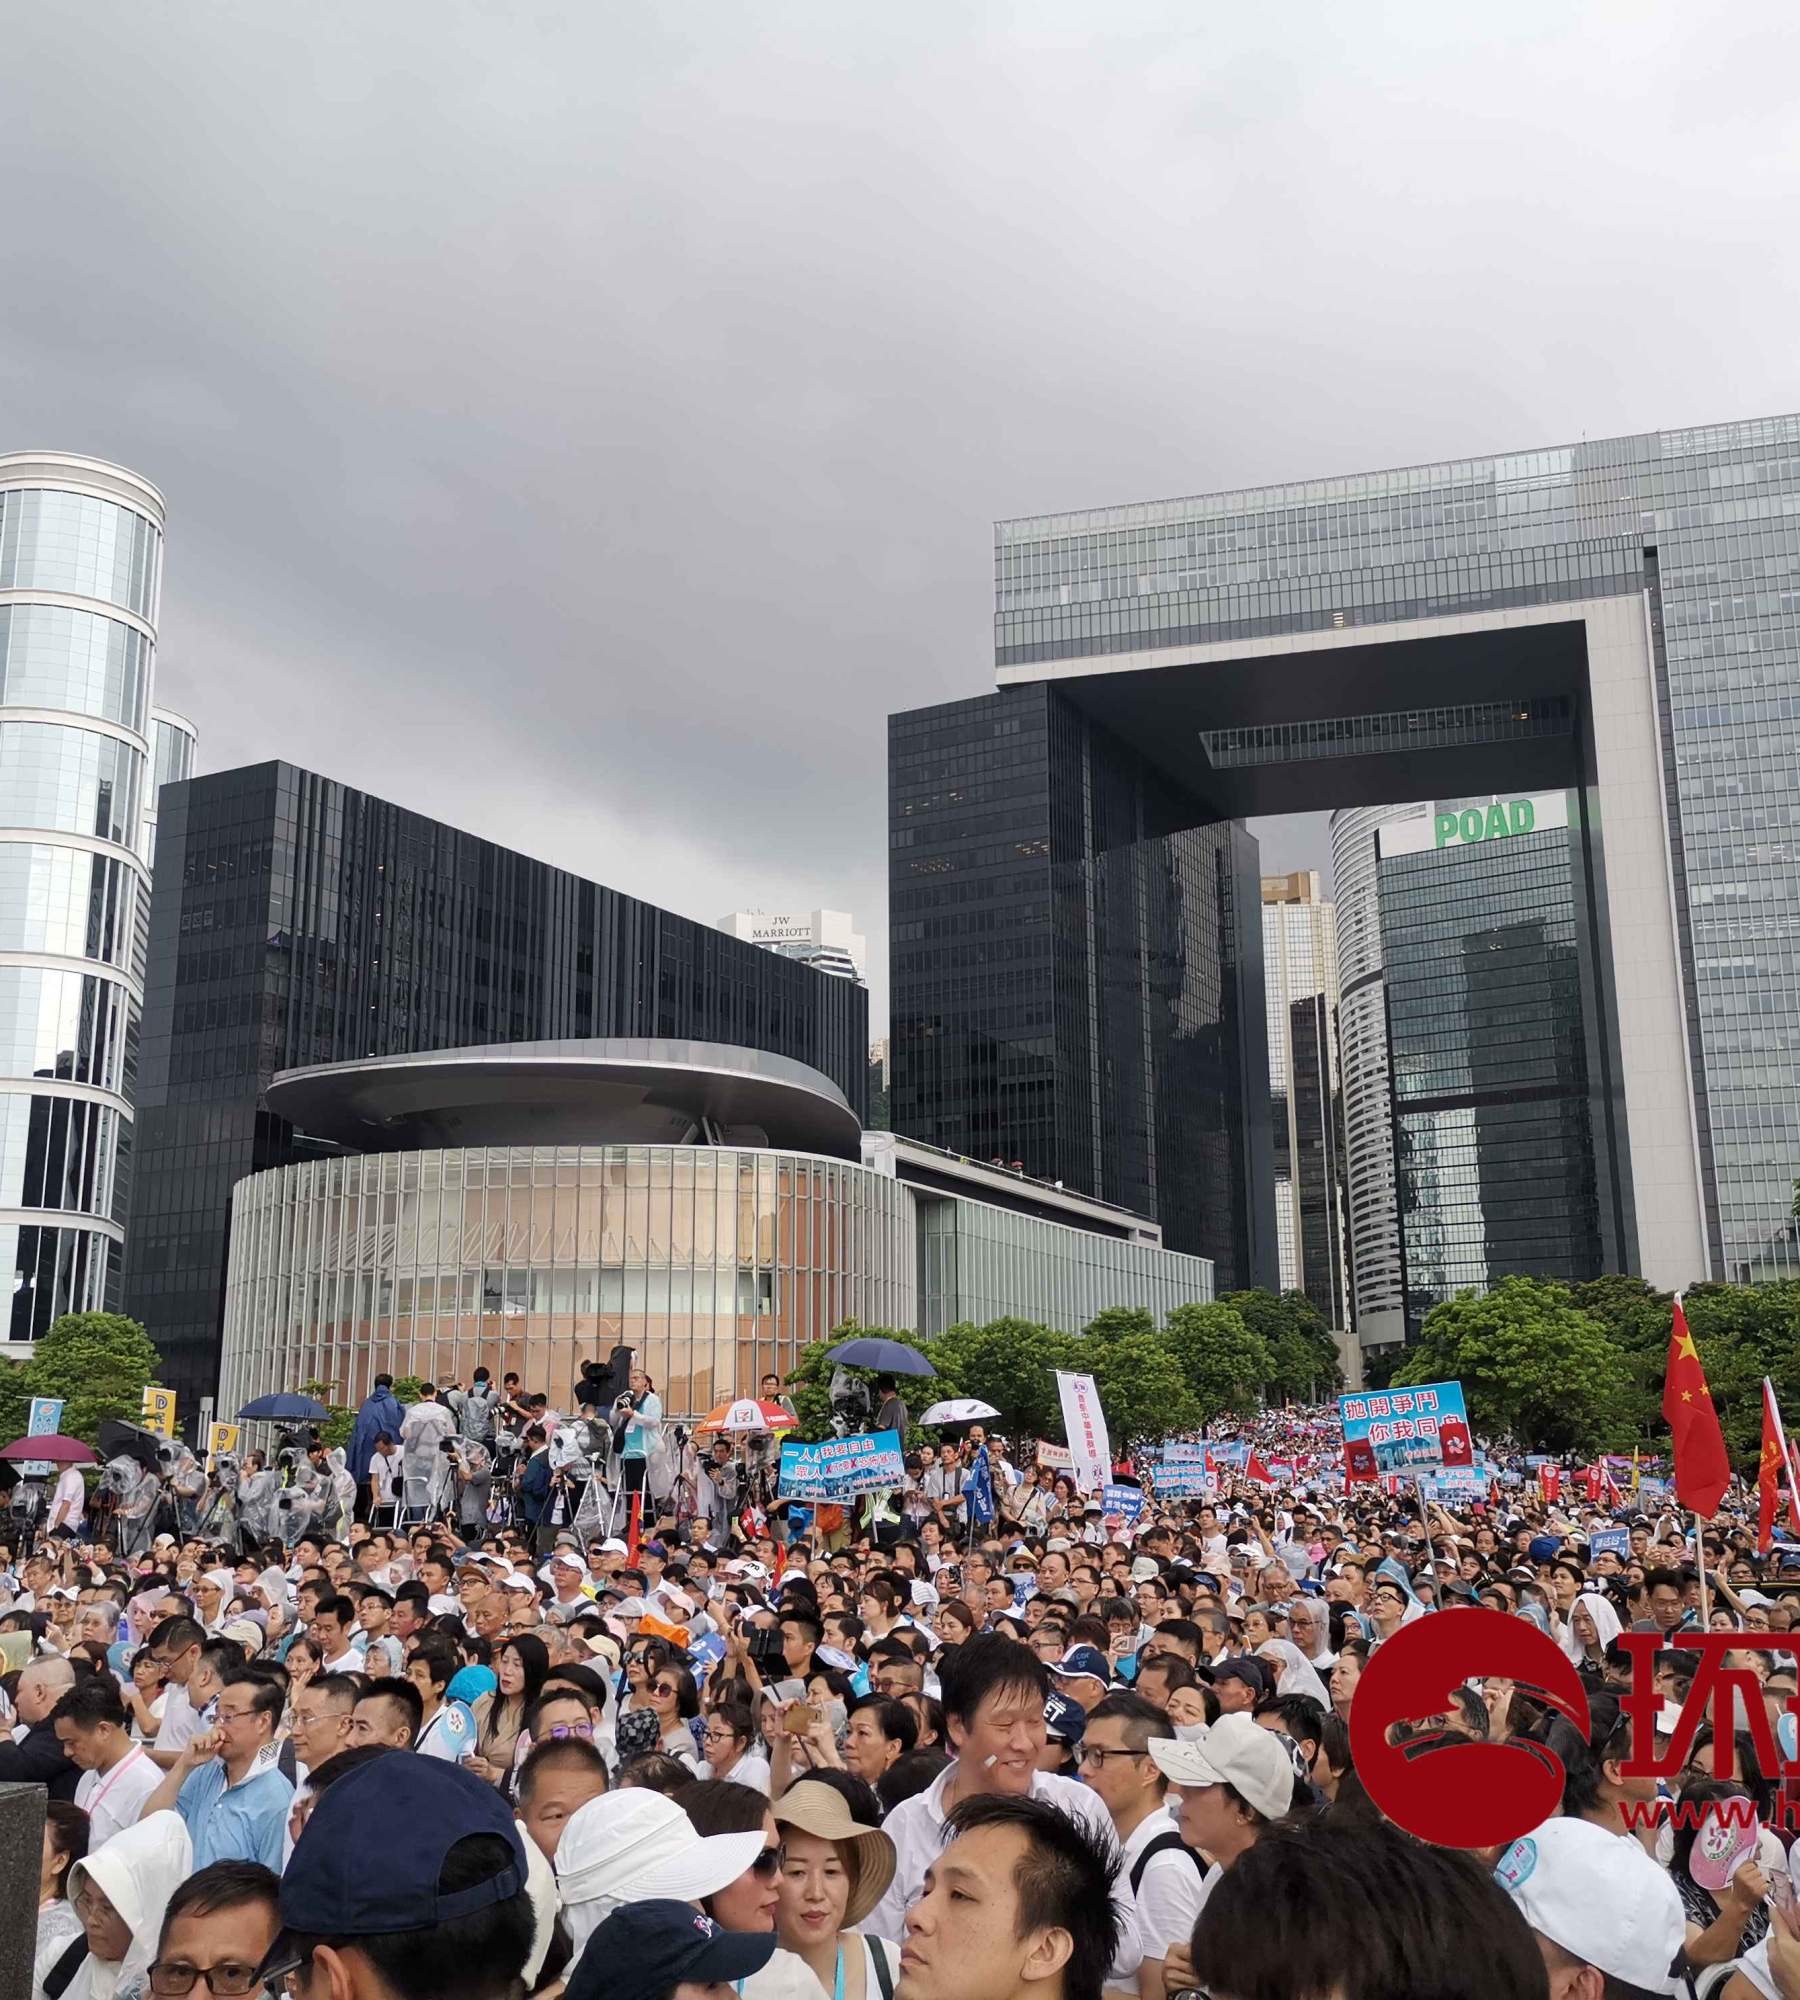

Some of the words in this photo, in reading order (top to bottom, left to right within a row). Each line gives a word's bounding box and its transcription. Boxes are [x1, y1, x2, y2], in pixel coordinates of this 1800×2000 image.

[1434, 799, 1535, 848] POAD
[772, 916, 790, 925] JW
[752, 927, 811, 938] MARRIOTT
